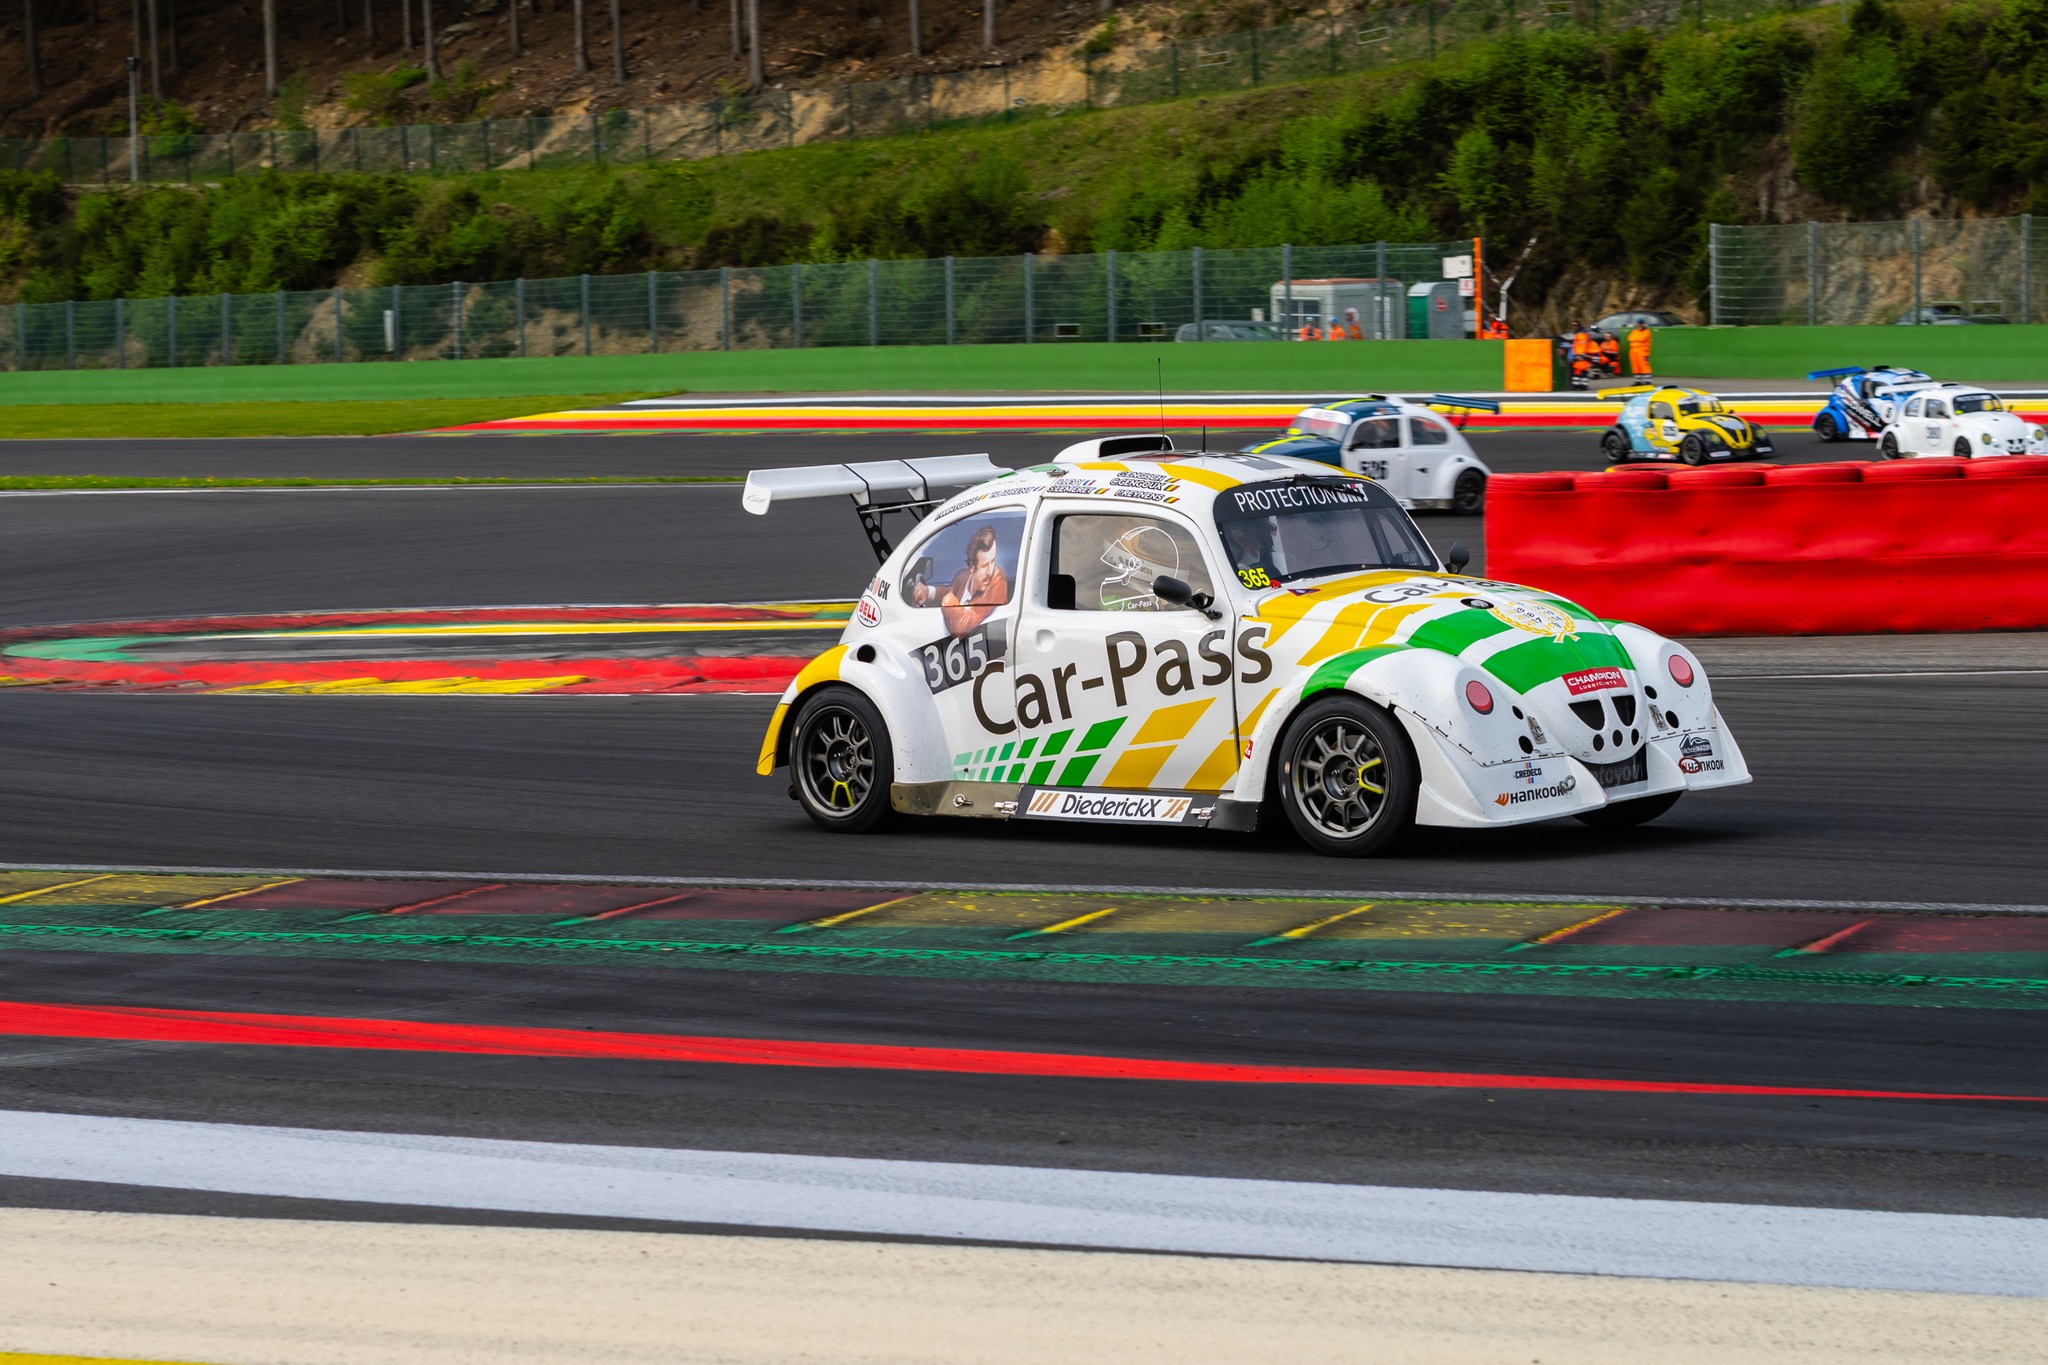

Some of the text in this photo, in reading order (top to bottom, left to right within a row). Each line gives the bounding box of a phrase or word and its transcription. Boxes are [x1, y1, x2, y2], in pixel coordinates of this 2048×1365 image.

[1234, 484, 1338, 513] PROTECTION
[1238, 567, 1271, 589] 365
[859, 599, 877, 622] BELL
[1127, 600, 1153, 610] Car-Pass
[972, 626, 1273, 736] Car-Pass
[1567, 671, 1621, 687] CHAMPION
[1514, 767, 1542, 779] CREDECO
